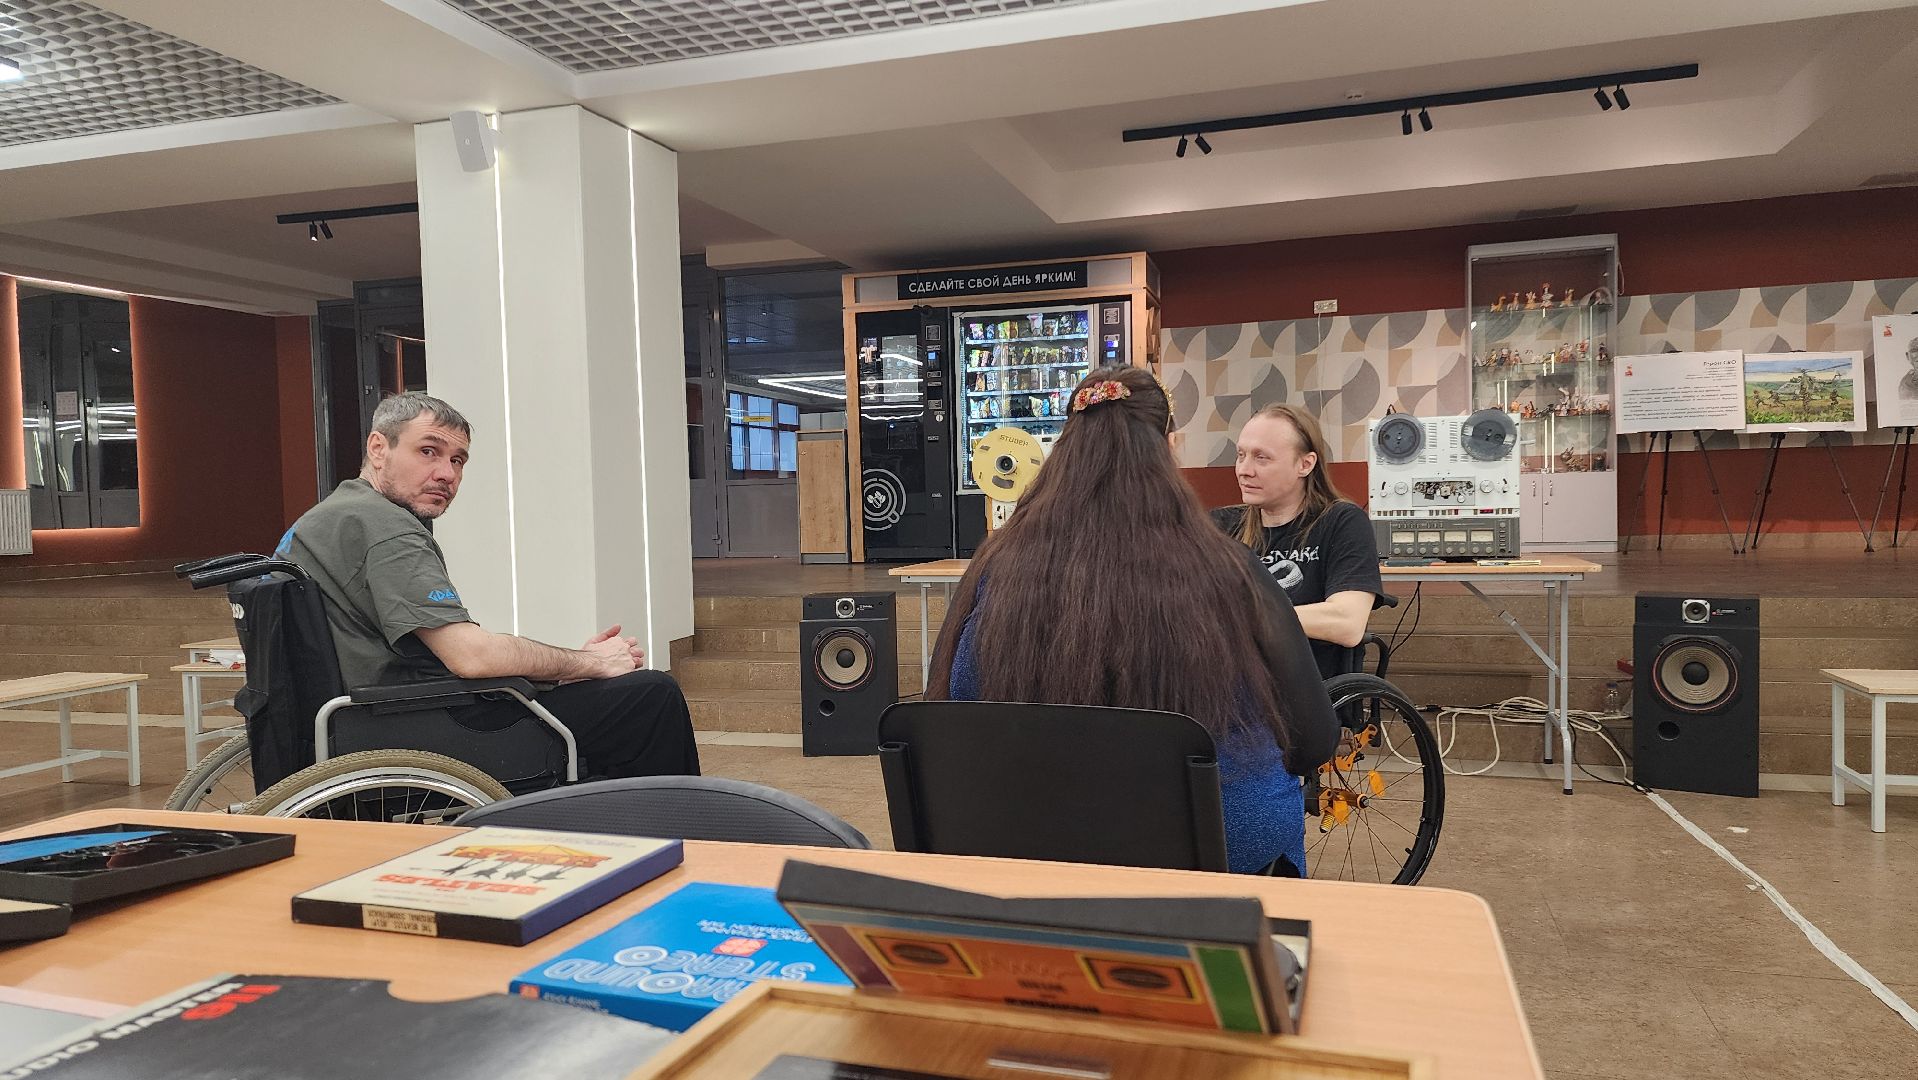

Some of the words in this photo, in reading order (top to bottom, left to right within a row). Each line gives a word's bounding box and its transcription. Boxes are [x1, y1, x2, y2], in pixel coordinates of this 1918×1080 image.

[908, 278, 965, 294] СДЕЛАЙТЕ
[967, 275, 1000, 289] СВОЙ
[1002, 274, 1031, 287] ДЕНЬ
[1034, 270, 1077, 284] ЯРКИМ!
[1000, 434, 1029, 447] STUDER
[1259, 546, 1319, 563] SNAKE
[100, 982, 245, 1040] MASTER
